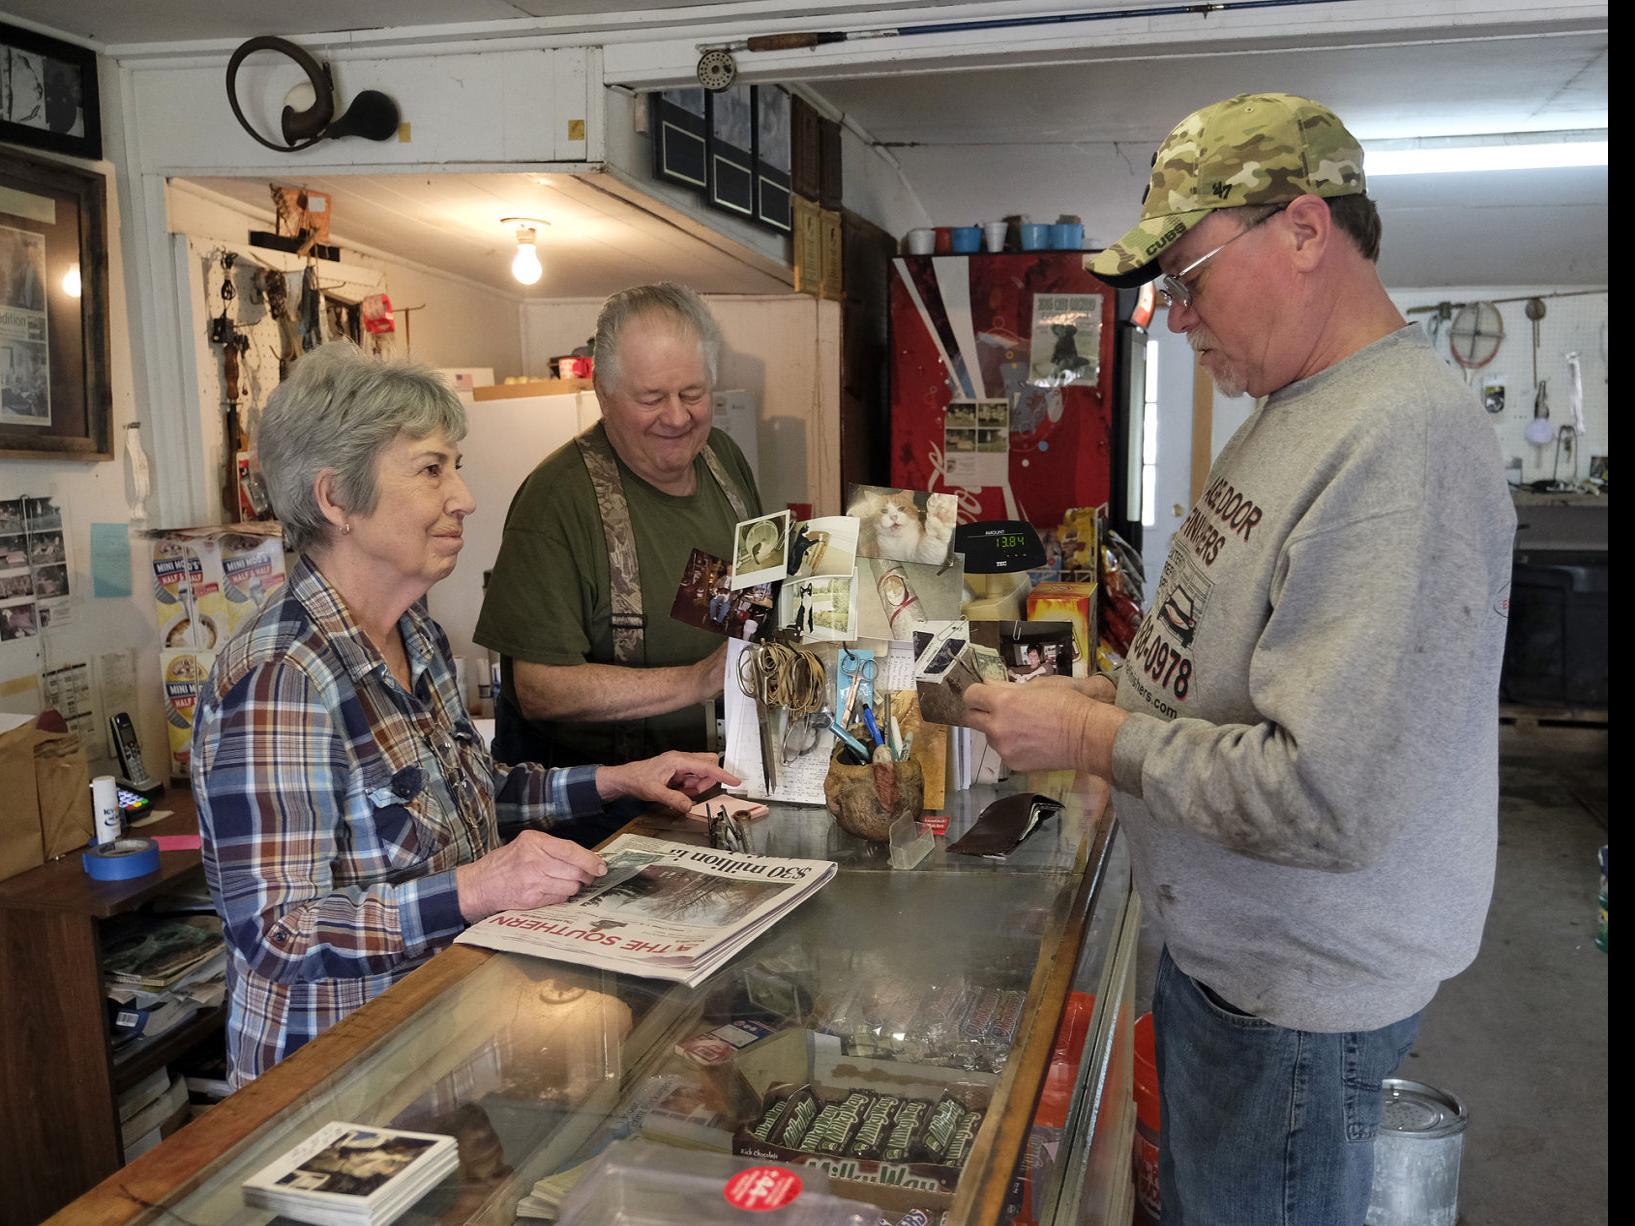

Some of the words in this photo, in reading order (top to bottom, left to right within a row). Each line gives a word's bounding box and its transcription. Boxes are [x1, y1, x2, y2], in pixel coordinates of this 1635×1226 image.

[1145, 222, 1188, 256] CUBS
[1215, 486, 1263, 542] DOOR
[156, 562, 174, 573] MINI
[226, 560, 245, 572] MINI
[161, 575, 180, 584] HALF
[231, 571, 250, 585] HALF
[169, 685, 188, 695] MINI
[175, 698, 192, 707] HALF
[690, 853, 768, 876] million
[766, 866, 812, 880] $30
[487, 915, 624, 947] SOUTHERN
[620, 939, 673, 955] THE
